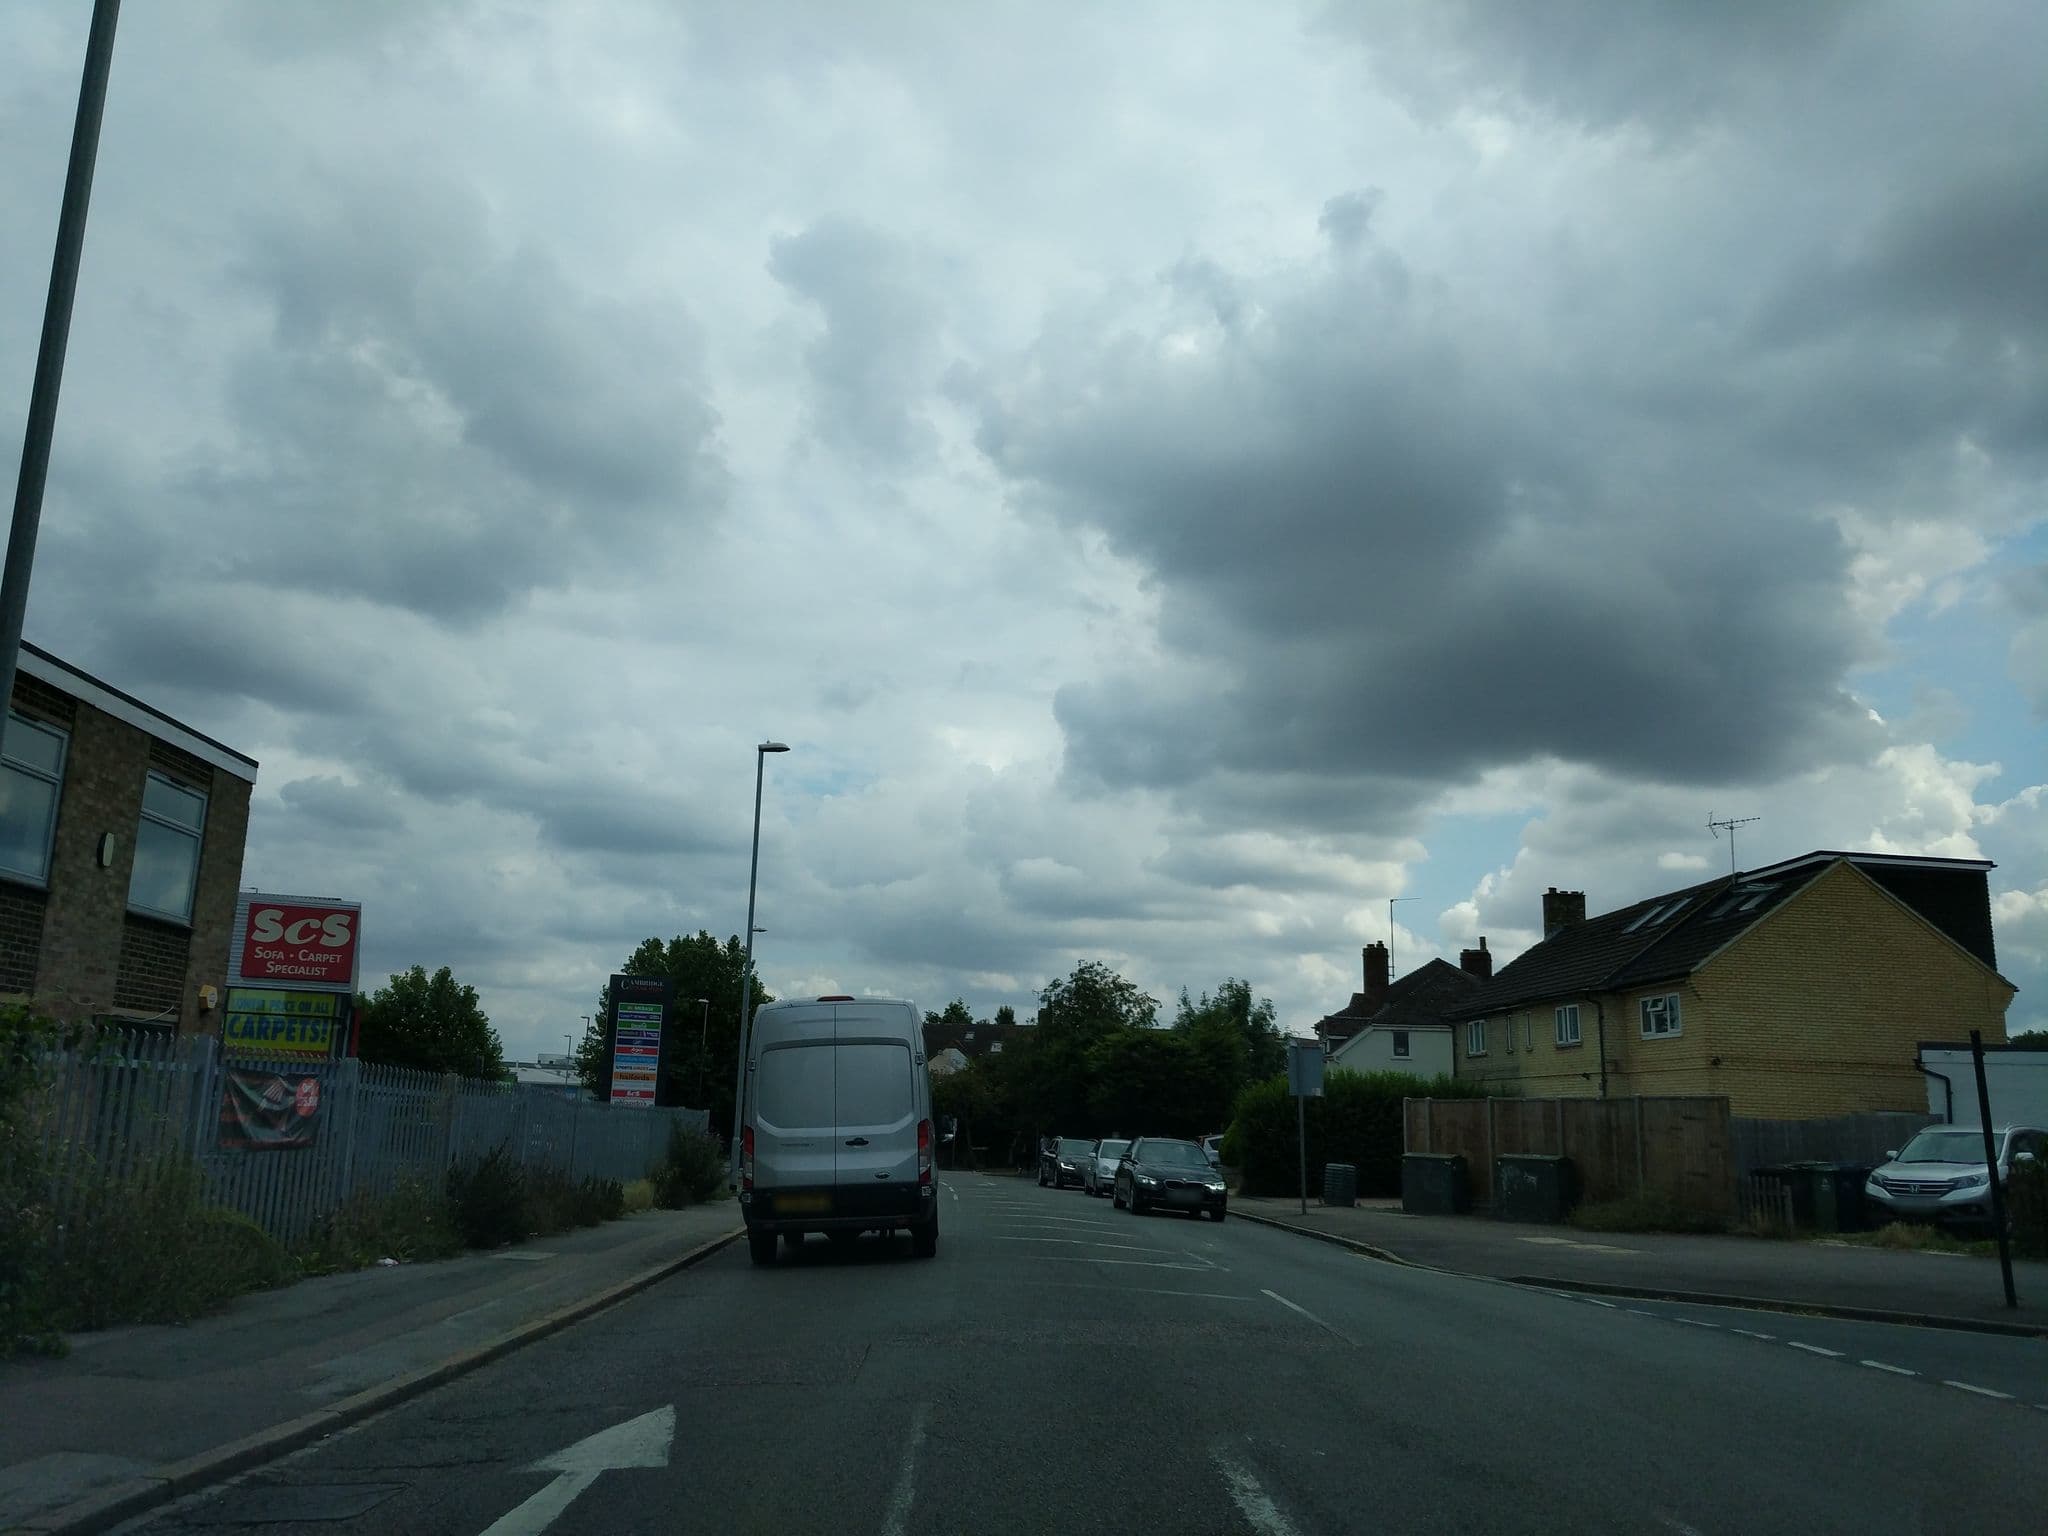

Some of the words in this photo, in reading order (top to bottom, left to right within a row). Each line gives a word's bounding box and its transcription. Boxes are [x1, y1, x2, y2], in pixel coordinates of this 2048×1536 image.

[254, 946, 285, 961] SOFA
[298, 949, 343, 964] CARPET
[265, 961, 328, 977] SPECIALIST
[227, 1014, 329, 1043] CARPETS!
